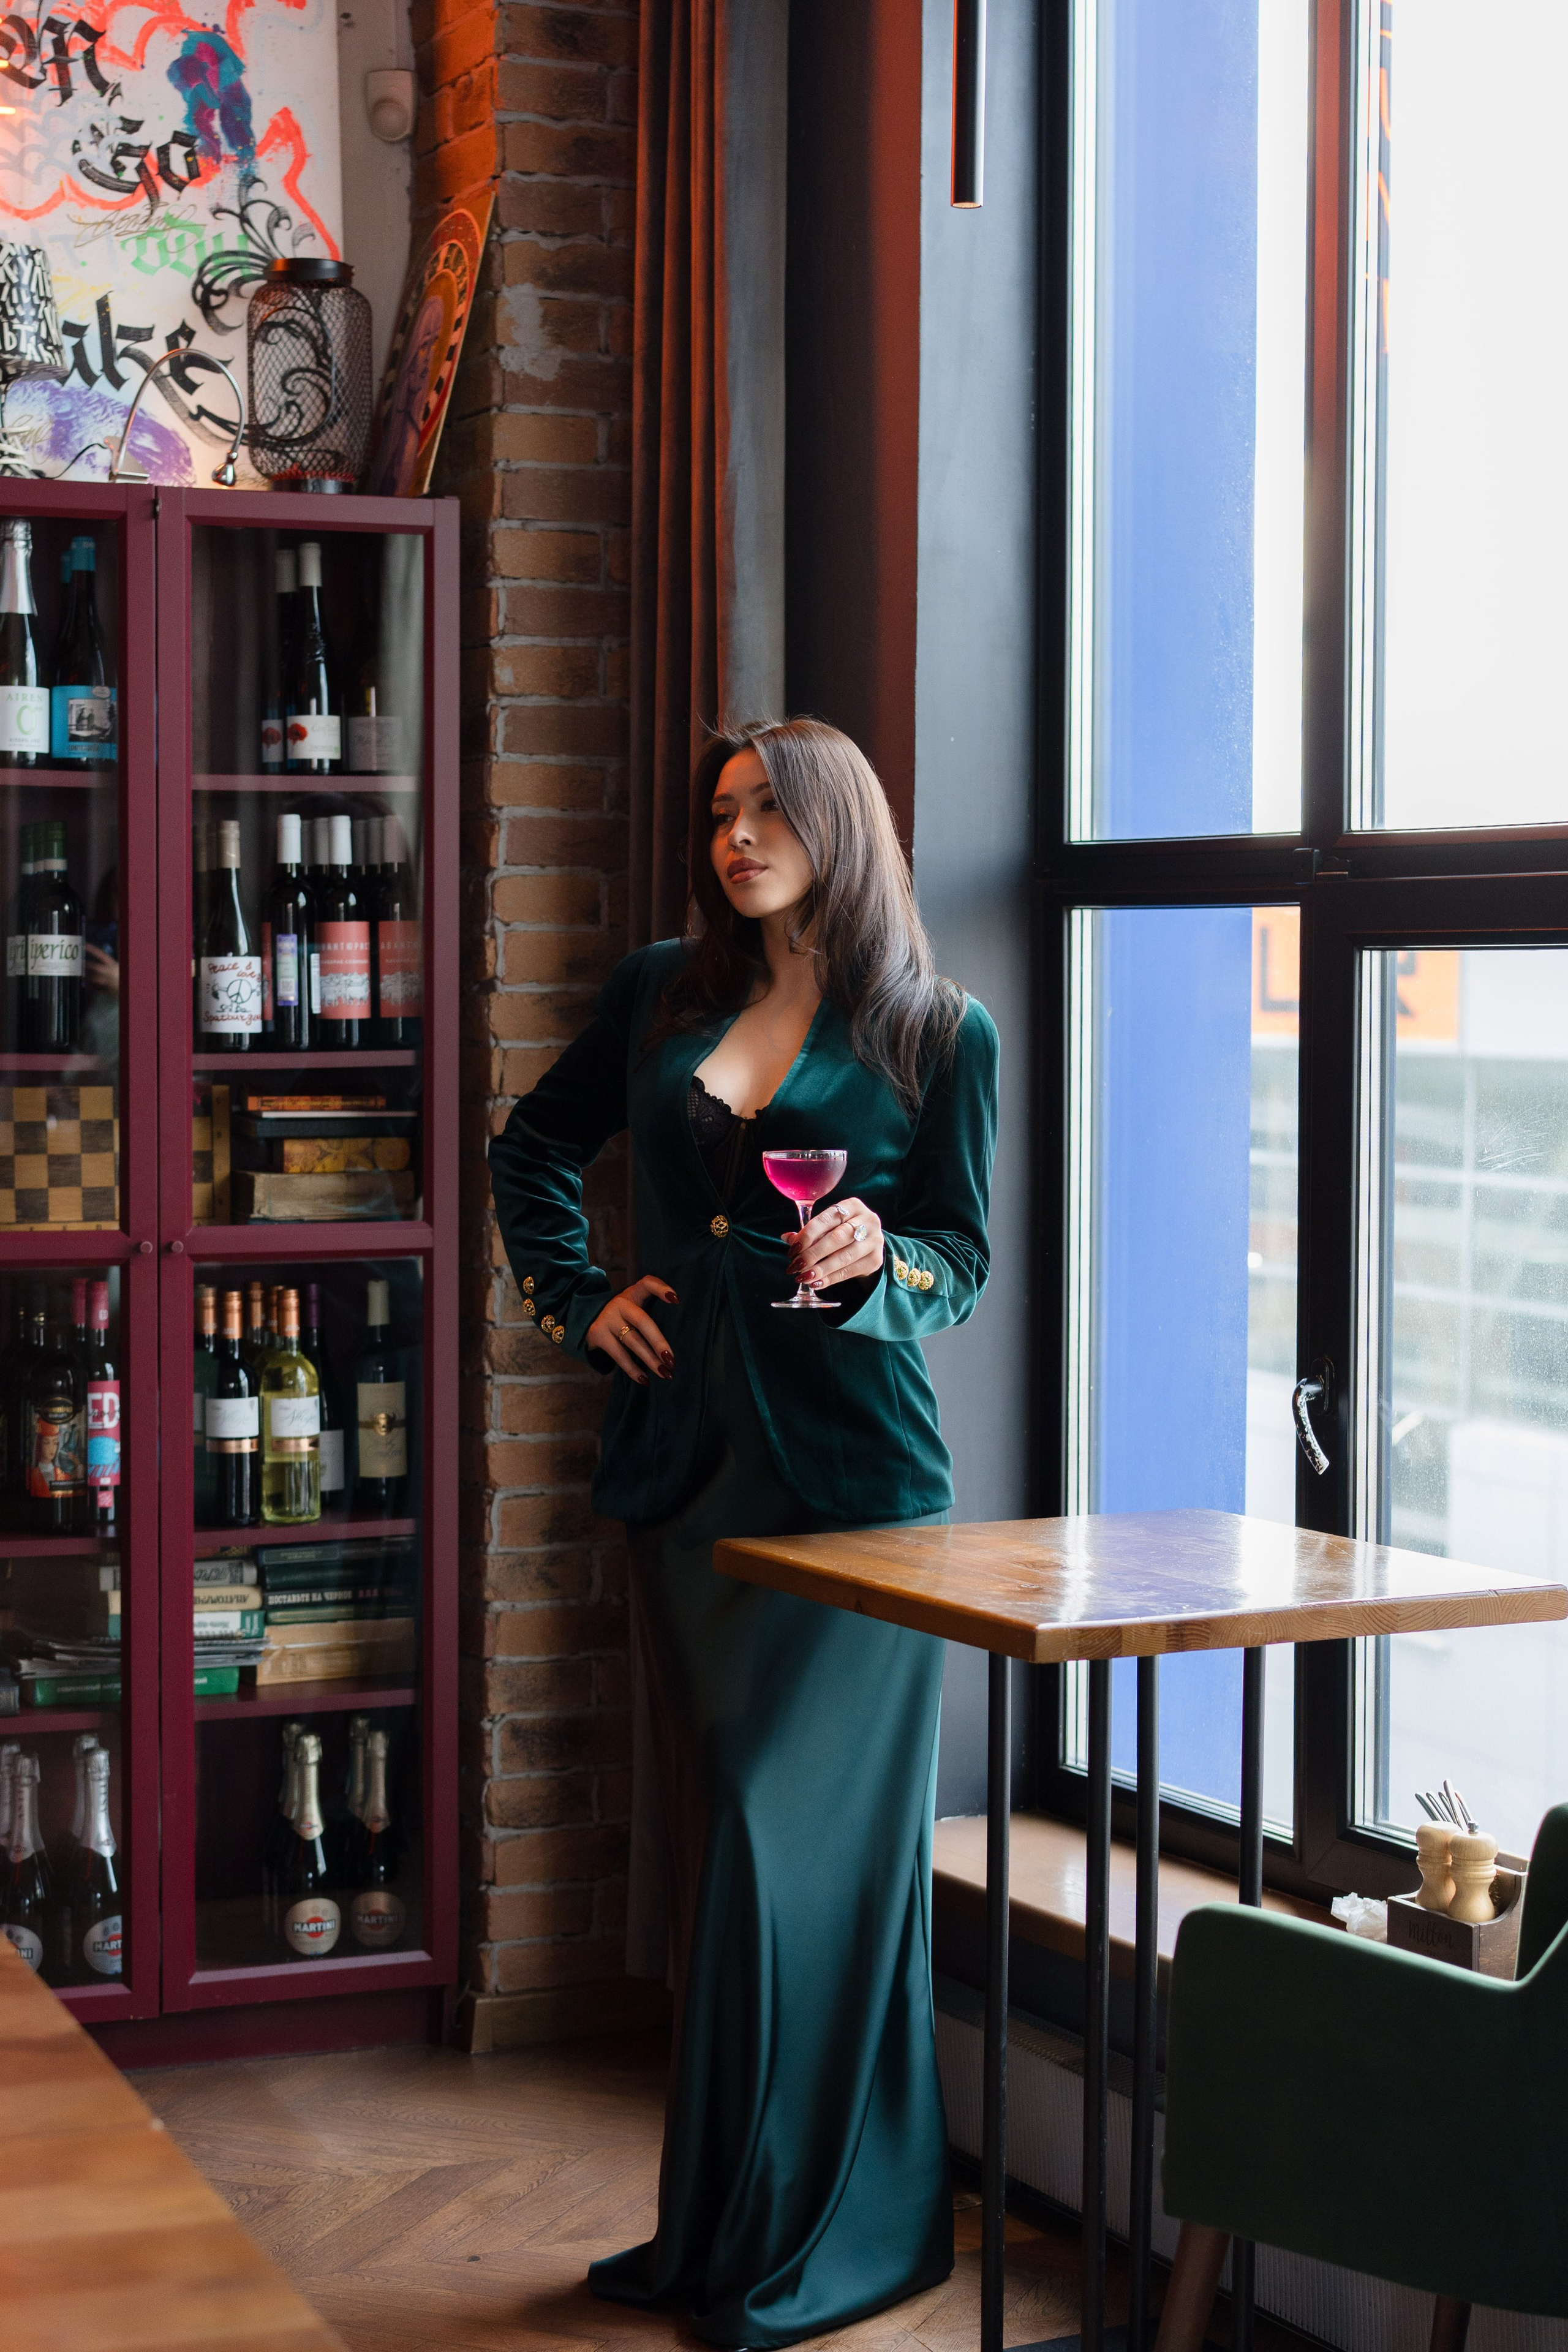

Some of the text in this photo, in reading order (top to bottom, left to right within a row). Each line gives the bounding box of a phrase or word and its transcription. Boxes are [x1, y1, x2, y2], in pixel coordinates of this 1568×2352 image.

[208, 962, 239, 974] Peace
[268, 1593, 310, 1605] ПОСТАВЬТЕ
[311, 1592, 323, 1602] НА
[294, 1919, 336, 1932] MARTINI
[1408, 1918, 1454, 1949] Milton
[94, 1940, 122, 1951] MART
